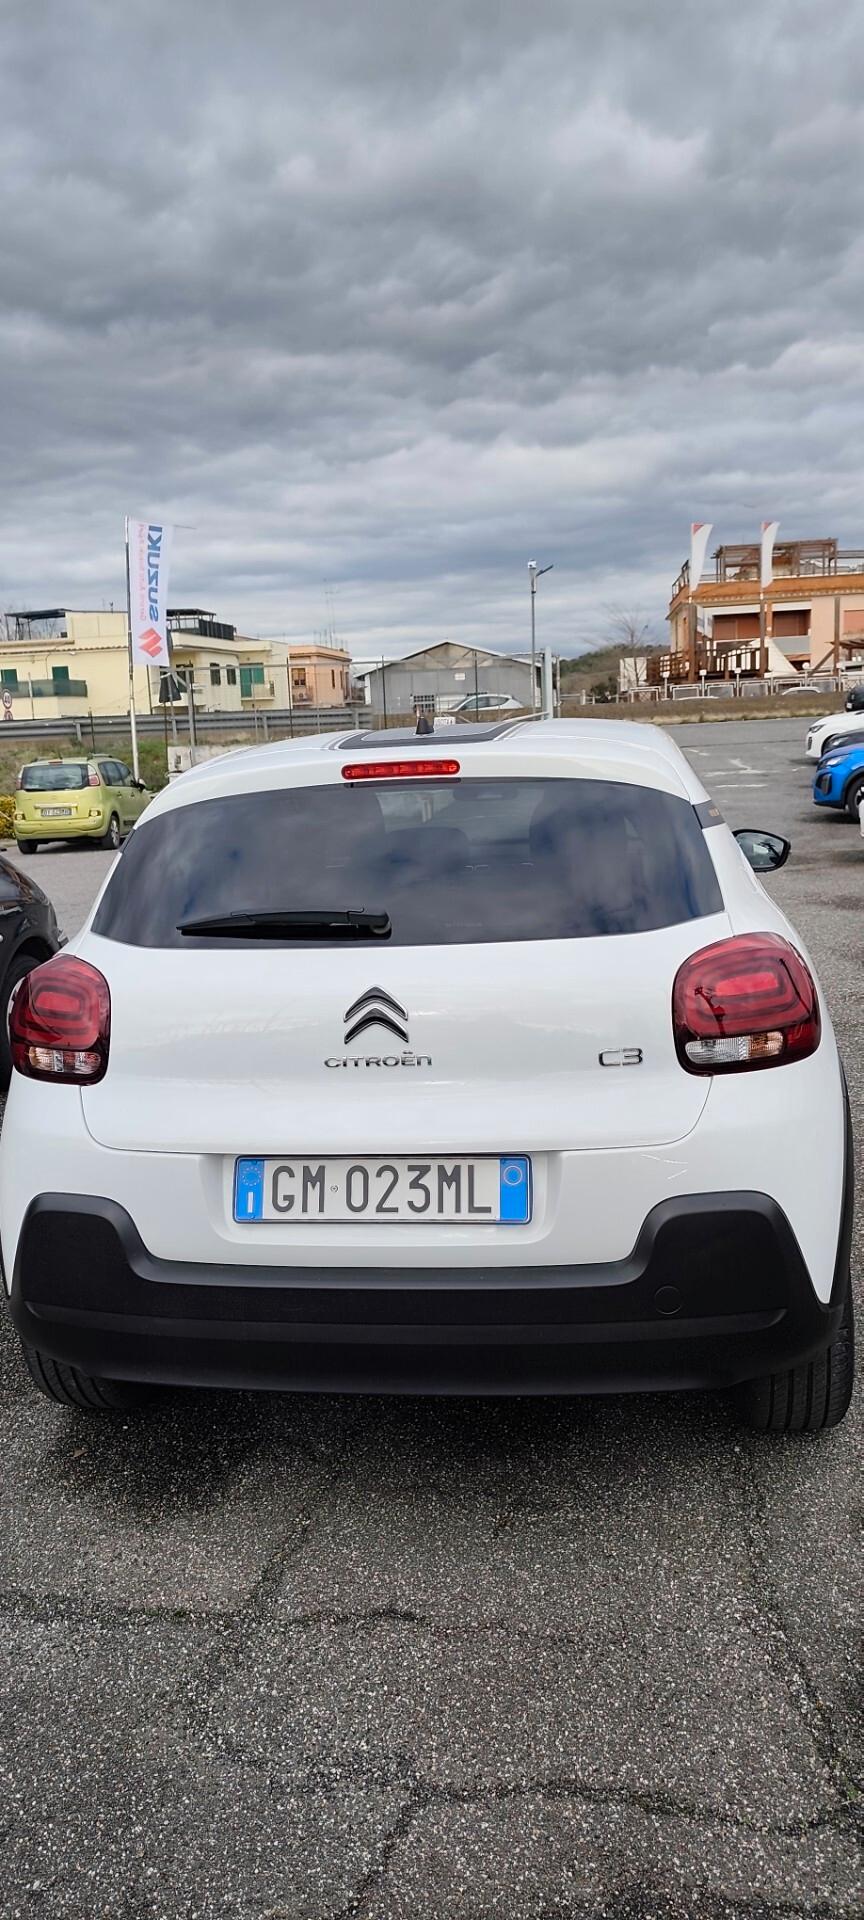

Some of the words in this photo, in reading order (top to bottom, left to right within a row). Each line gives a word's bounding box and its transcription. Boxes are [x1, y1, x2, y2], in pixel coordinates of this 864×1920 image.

[598, 1047, 643, 1067] C3
[271, 1165, 326, 1213] GM
[345, 1164, 492, 1214] 023ML
